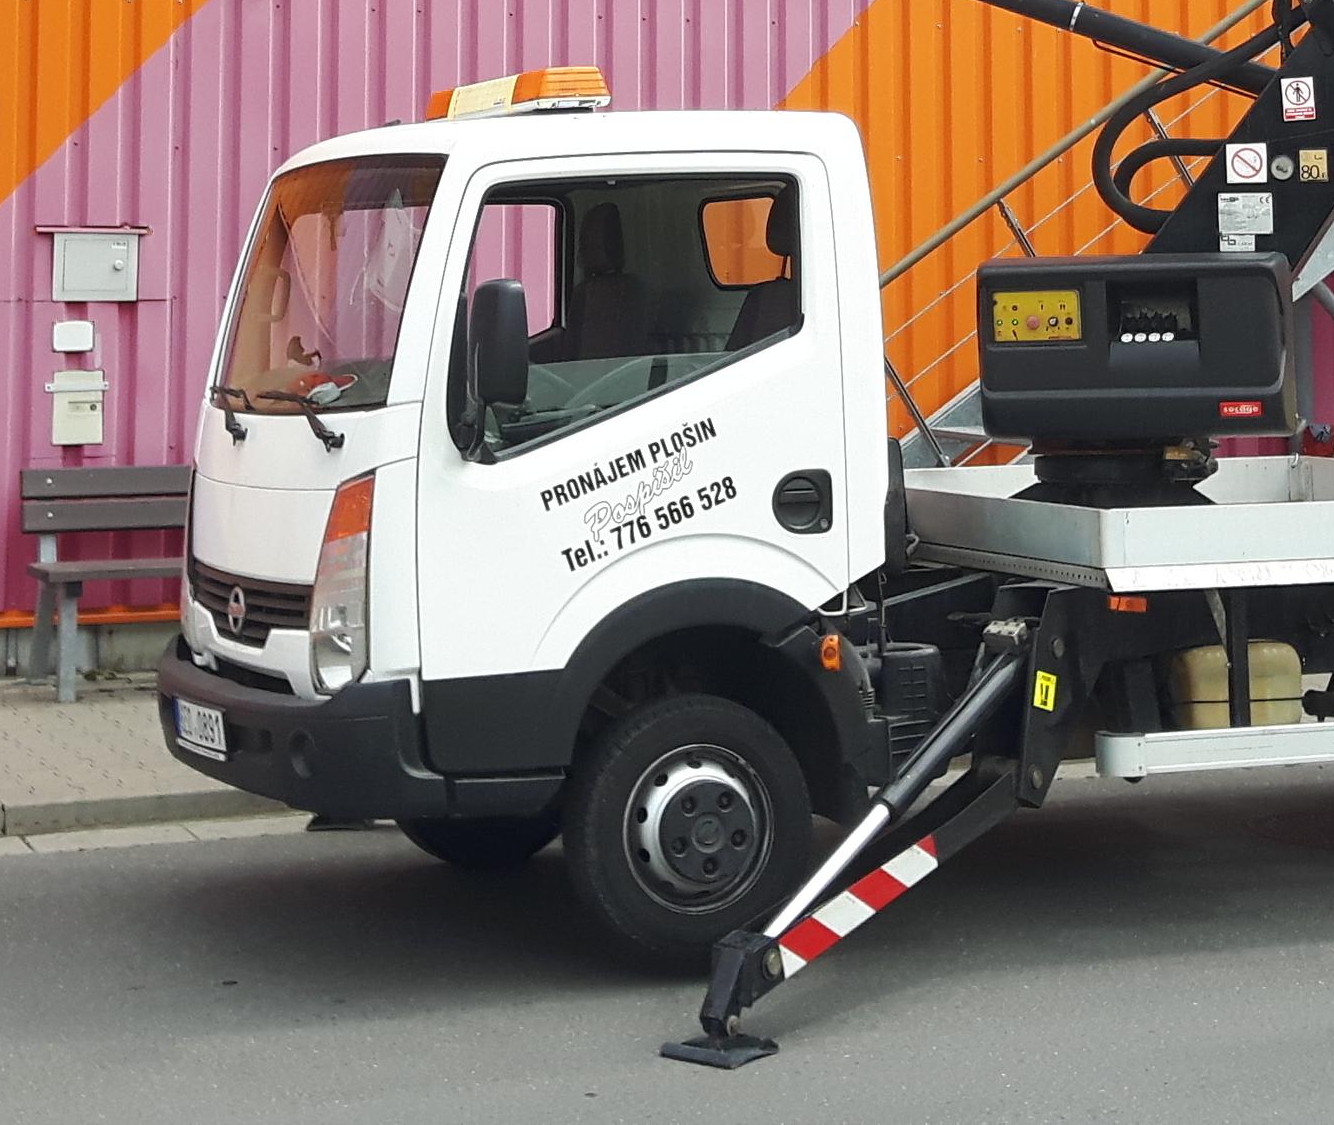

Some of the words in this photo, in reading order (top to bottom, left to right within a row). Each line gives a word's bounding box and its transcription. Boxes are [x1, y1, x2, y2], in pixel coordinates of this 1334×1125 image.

[539, 447, 648, 512] PRONÁJEM
[647, 417, 717, 464] PLOŠIN
[583, 446, 694, 543] Pospíšil
[560, 538, 610, 572] Tel.:
[609, 514, 653, 551] 776
[653, 495, 696, 531] 566
[696, 475, 738, 511] 528
